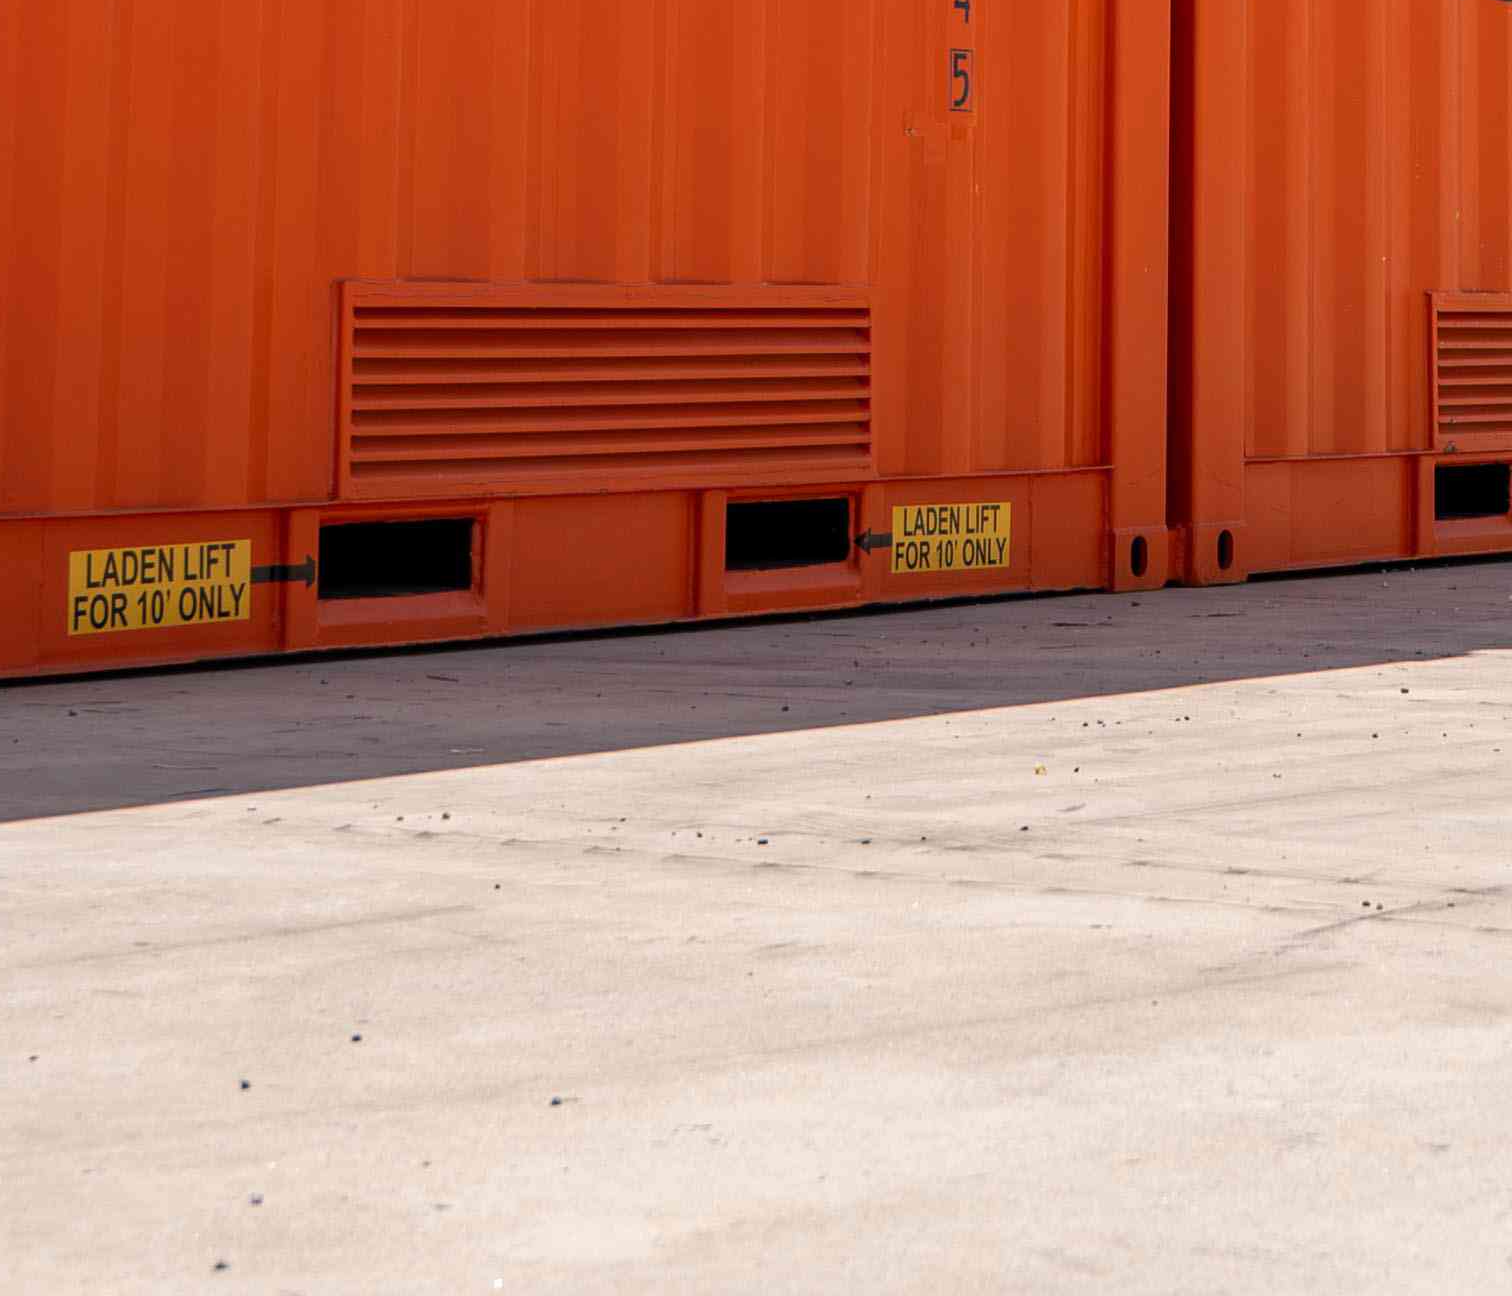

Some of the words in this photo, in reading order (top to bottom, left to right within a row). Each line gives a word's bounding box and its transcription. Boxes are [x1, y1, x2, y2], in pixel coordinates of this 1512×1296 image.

[904, 506, 960, 536] LADEN
[966, 505, 1000, 534] LIFT
[87, 547, 174, 588] LADEN
[184, 543, 235, 581] LIFT
[896, 541, 930, 570] FOR
[936, 539, 958, 568] 10'
[963, 538, 1007, 566] ONLY
[73, 592, 128, 631] FOR
[138, 588, 171, 625] 10'
[179, 582, 245, 622] ONLY
